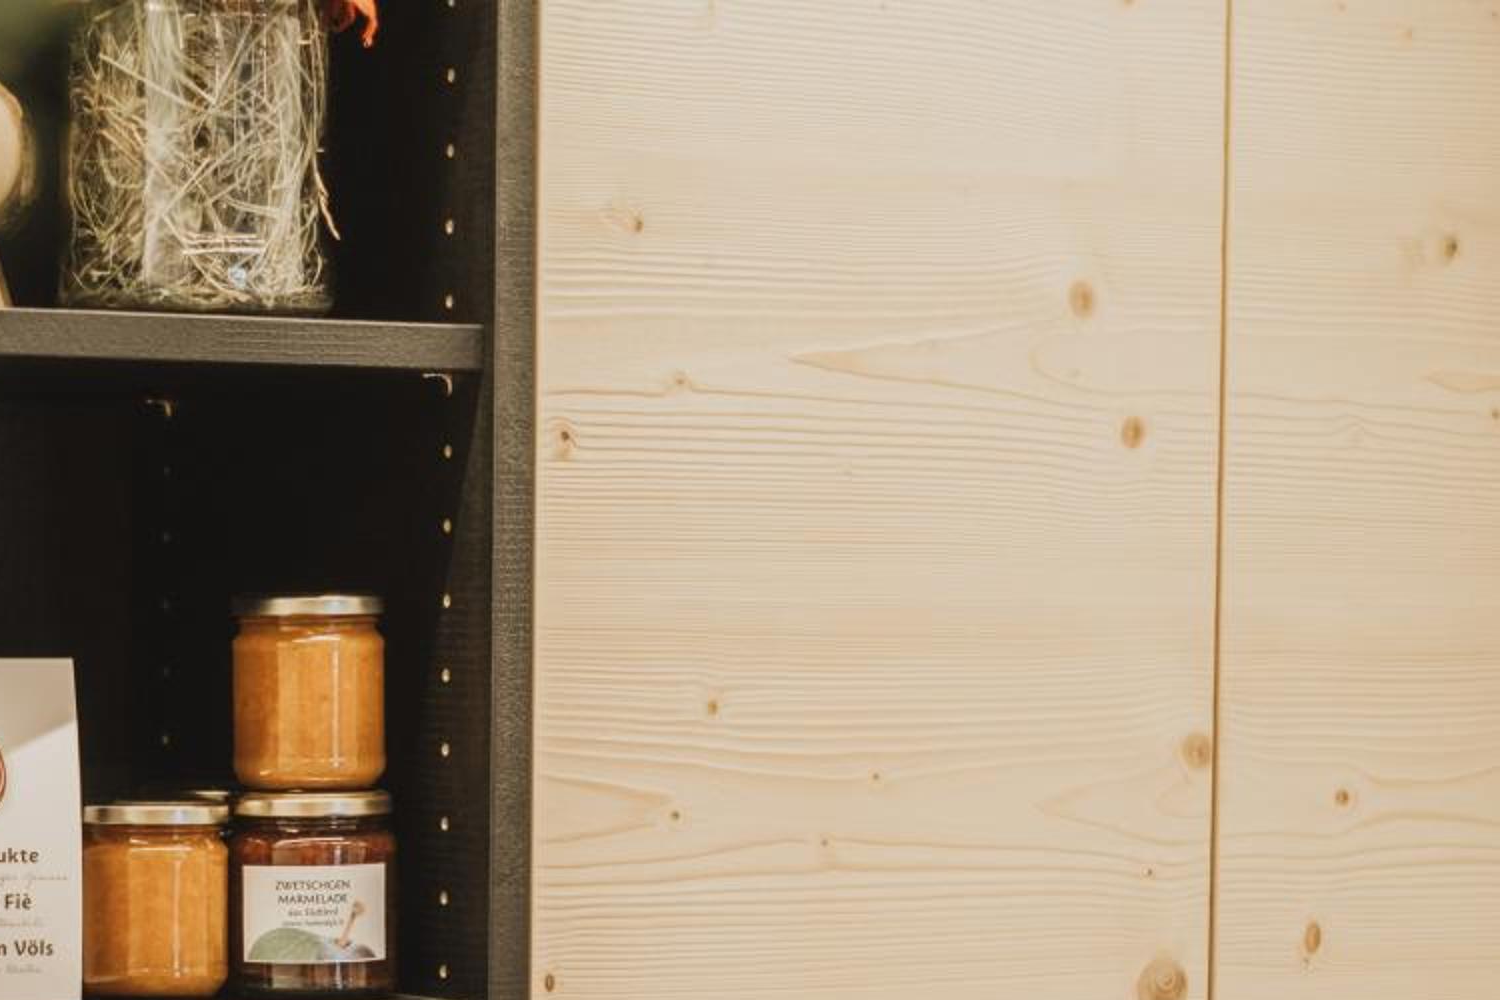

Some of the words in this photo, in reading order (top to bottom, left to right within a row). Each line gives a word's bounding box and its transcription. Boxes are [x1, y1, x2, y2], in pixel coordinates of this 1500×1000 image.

[275, 879, 351, 891] ZWETSCHGEN
[4, 894, 33, 911] Fiè
[277, 894, 348, 905] MARMELADE
[14, 940, 54, 956] Völs
